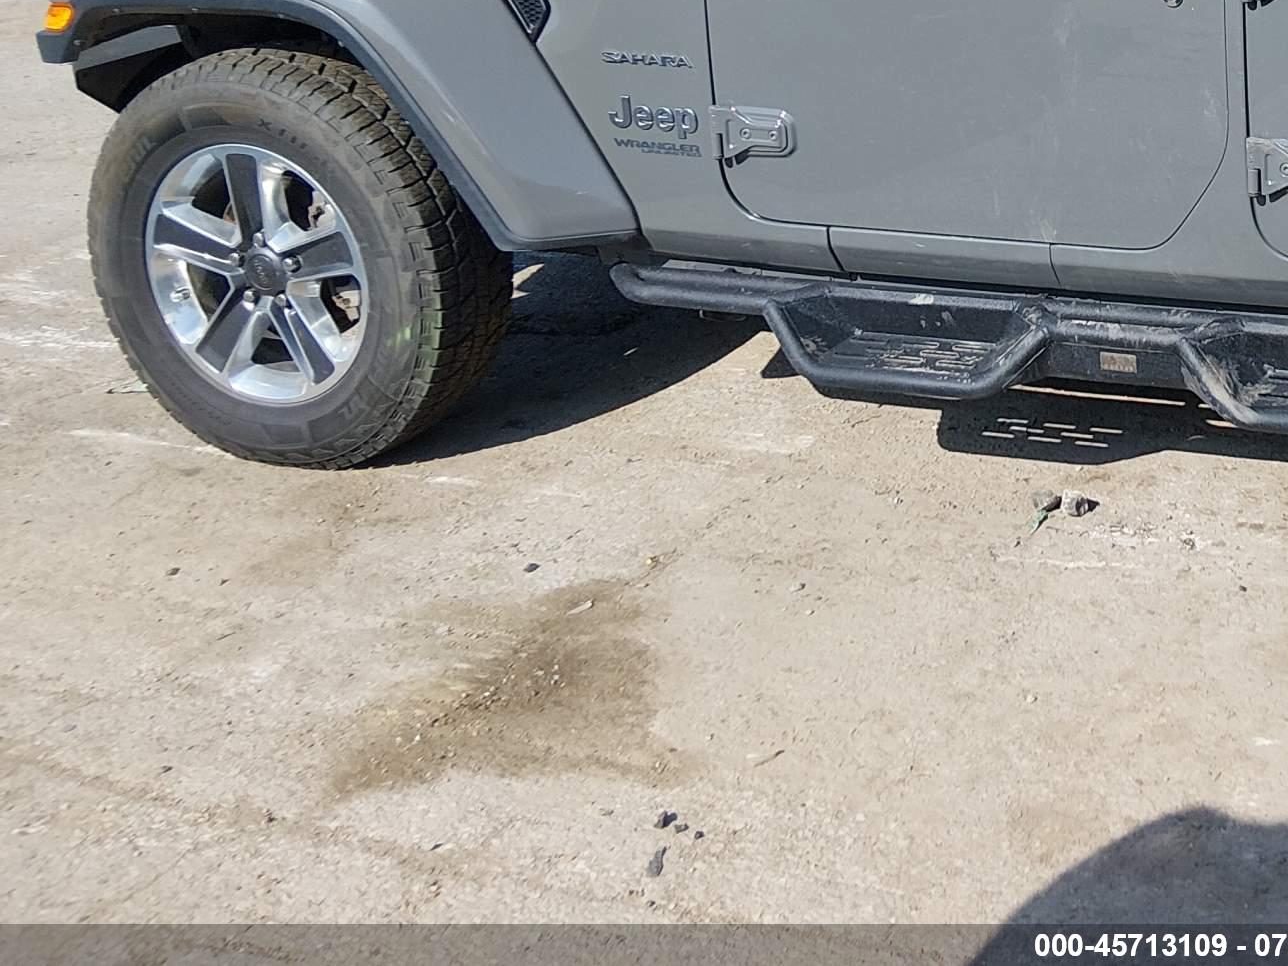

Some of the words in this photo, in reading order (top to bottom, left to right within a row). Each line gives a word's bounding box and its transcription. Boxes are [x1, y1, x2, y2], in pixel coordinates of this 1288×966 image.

[601, 50, 693, 69] SAHARA
[608, 95, 699, 139] Jeep
[613, 137, 701, 153] WRANGLER
